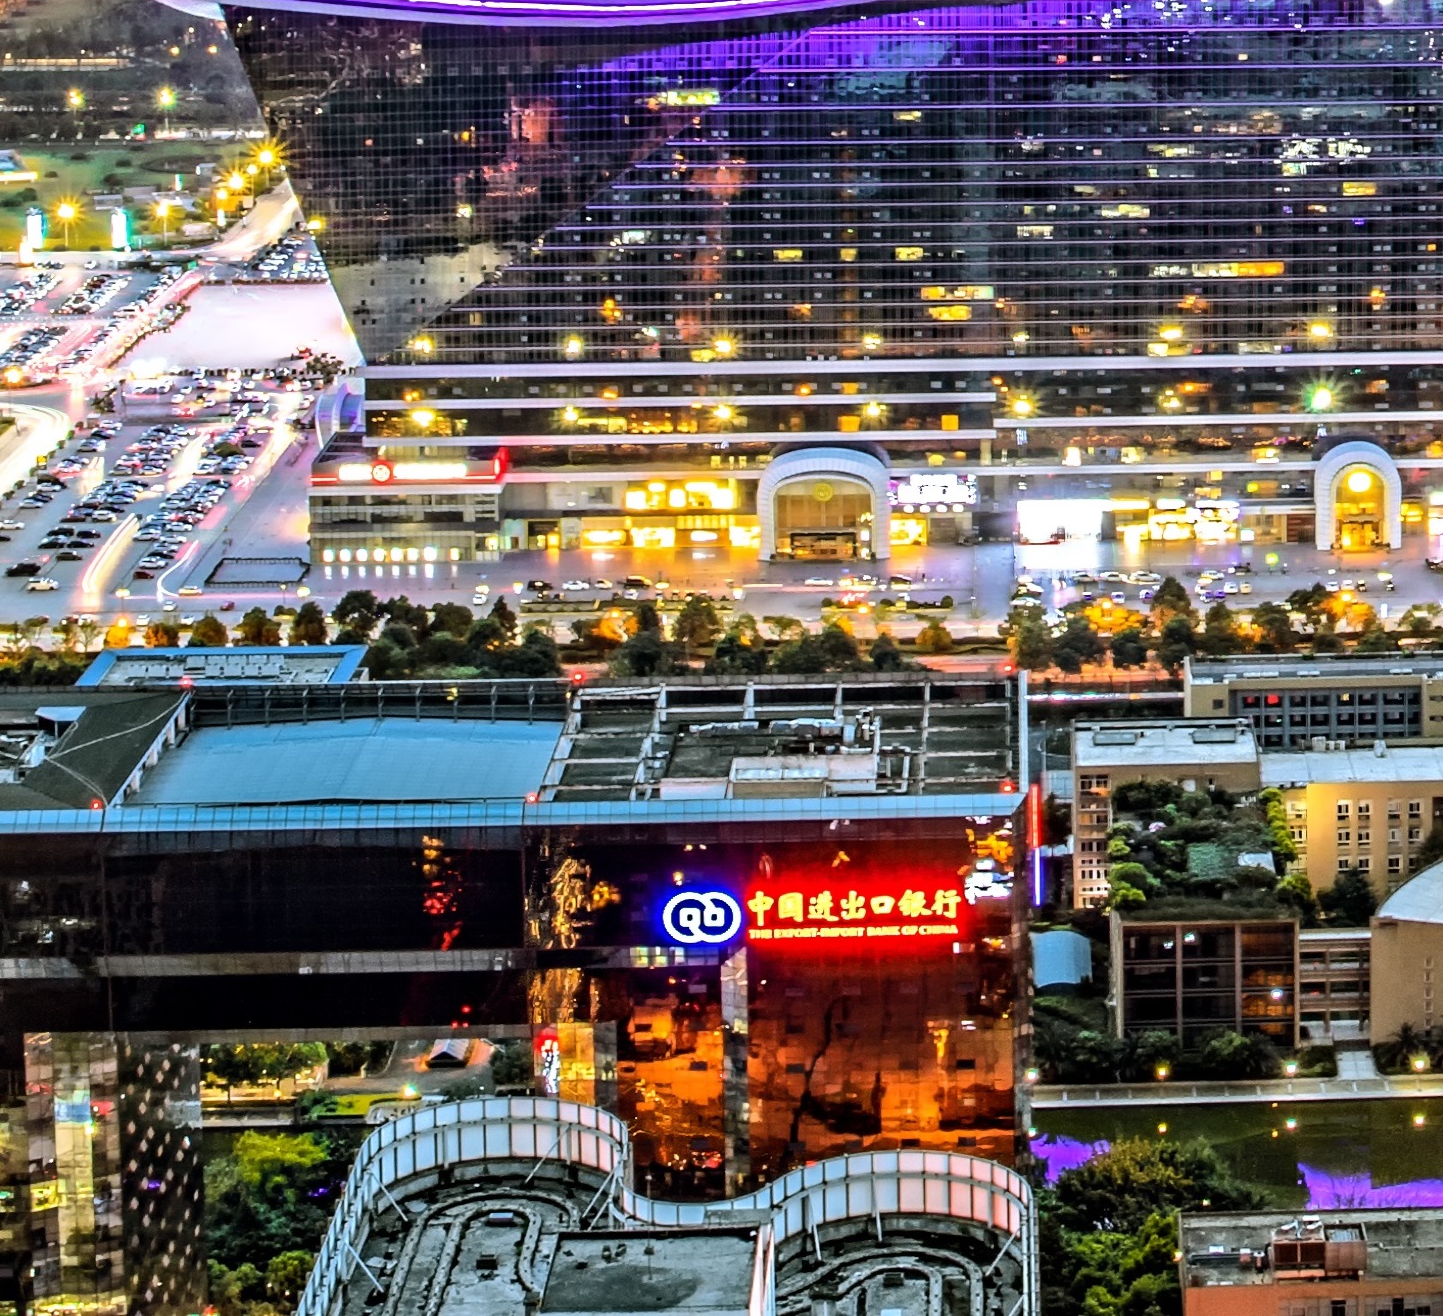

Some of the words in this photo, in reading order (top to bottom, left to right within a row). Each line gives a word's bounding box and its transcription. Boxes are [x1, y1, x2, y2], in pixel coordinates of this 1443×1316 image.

[747, 889, 962, 927] 中国进出口银行
[749, 929, 773, 939] THE
[867, 925, 901, 937] BANK
[901, 925, 919, 936] OF
[919, 924, 959, 936] CHINA
